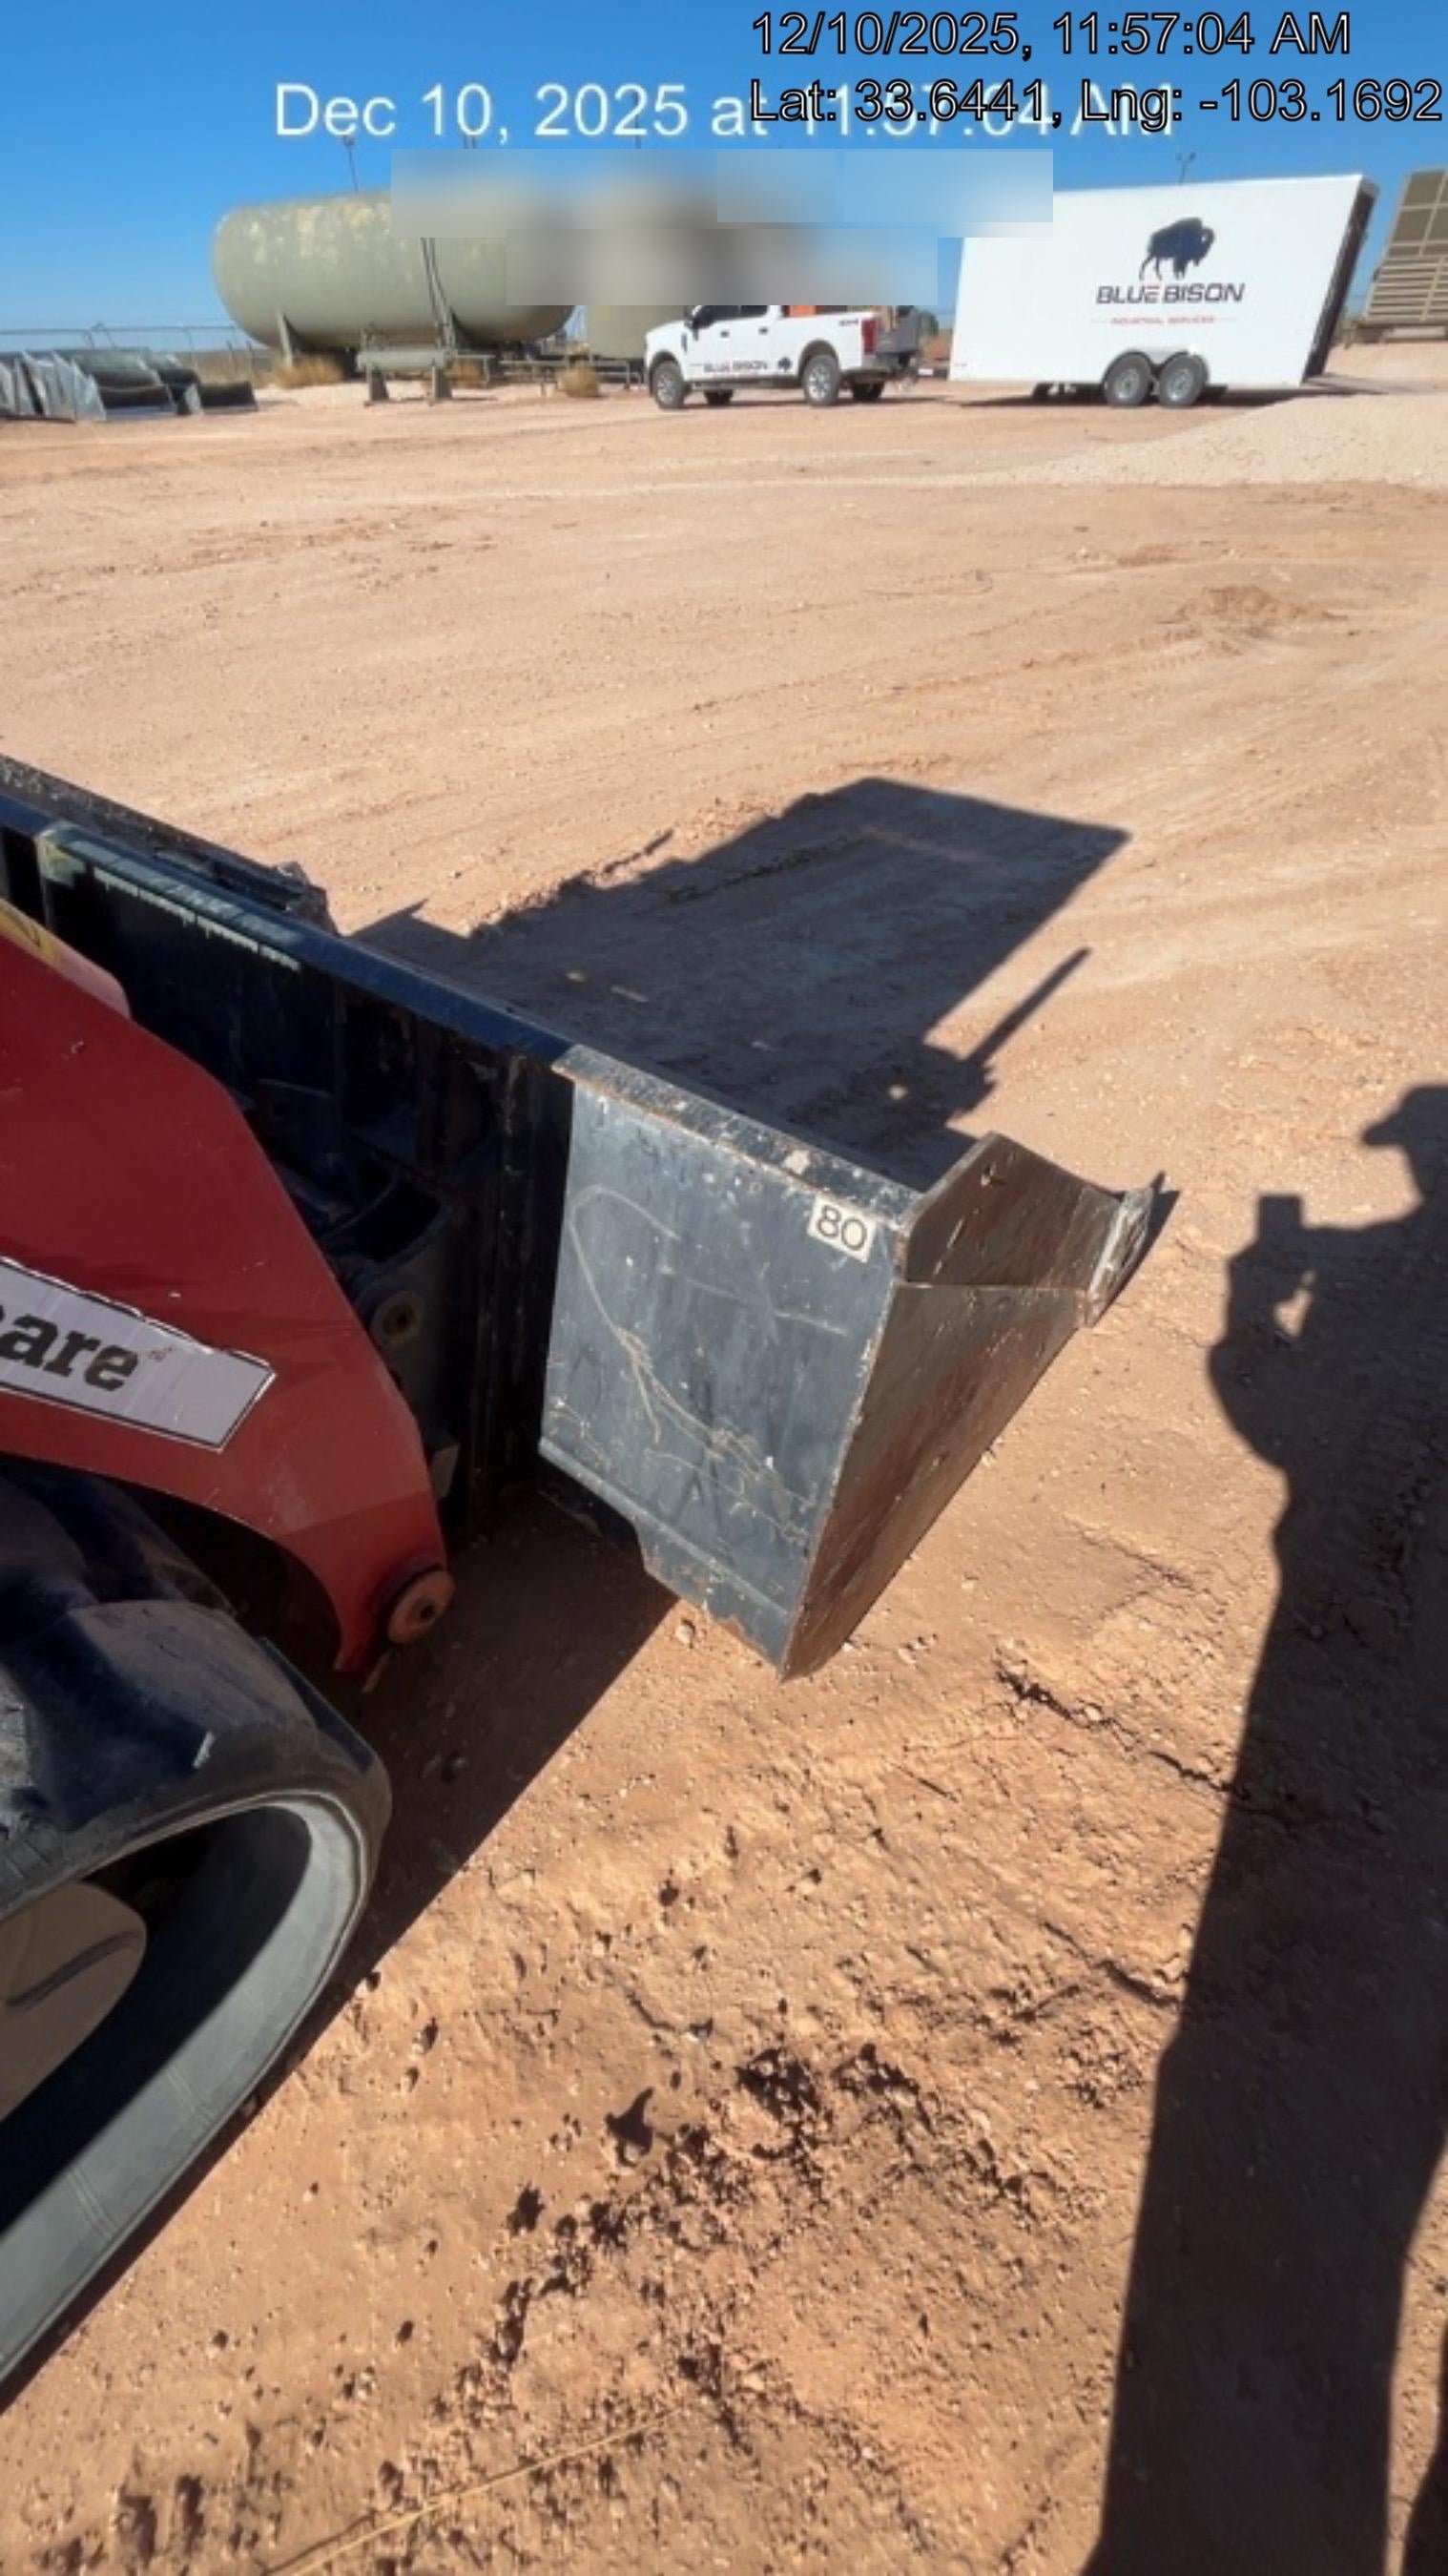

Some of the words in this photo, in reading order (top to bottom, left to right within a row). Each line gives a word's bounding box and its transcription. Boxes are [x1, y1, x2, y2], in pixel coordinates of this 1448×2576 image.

[1097, 285, 1160, 304] BLUE
[1162, 282, 1246, 303] BISON
[816, 1204, 868, 1252] 80
[0, 1304, 139, 1392] are
